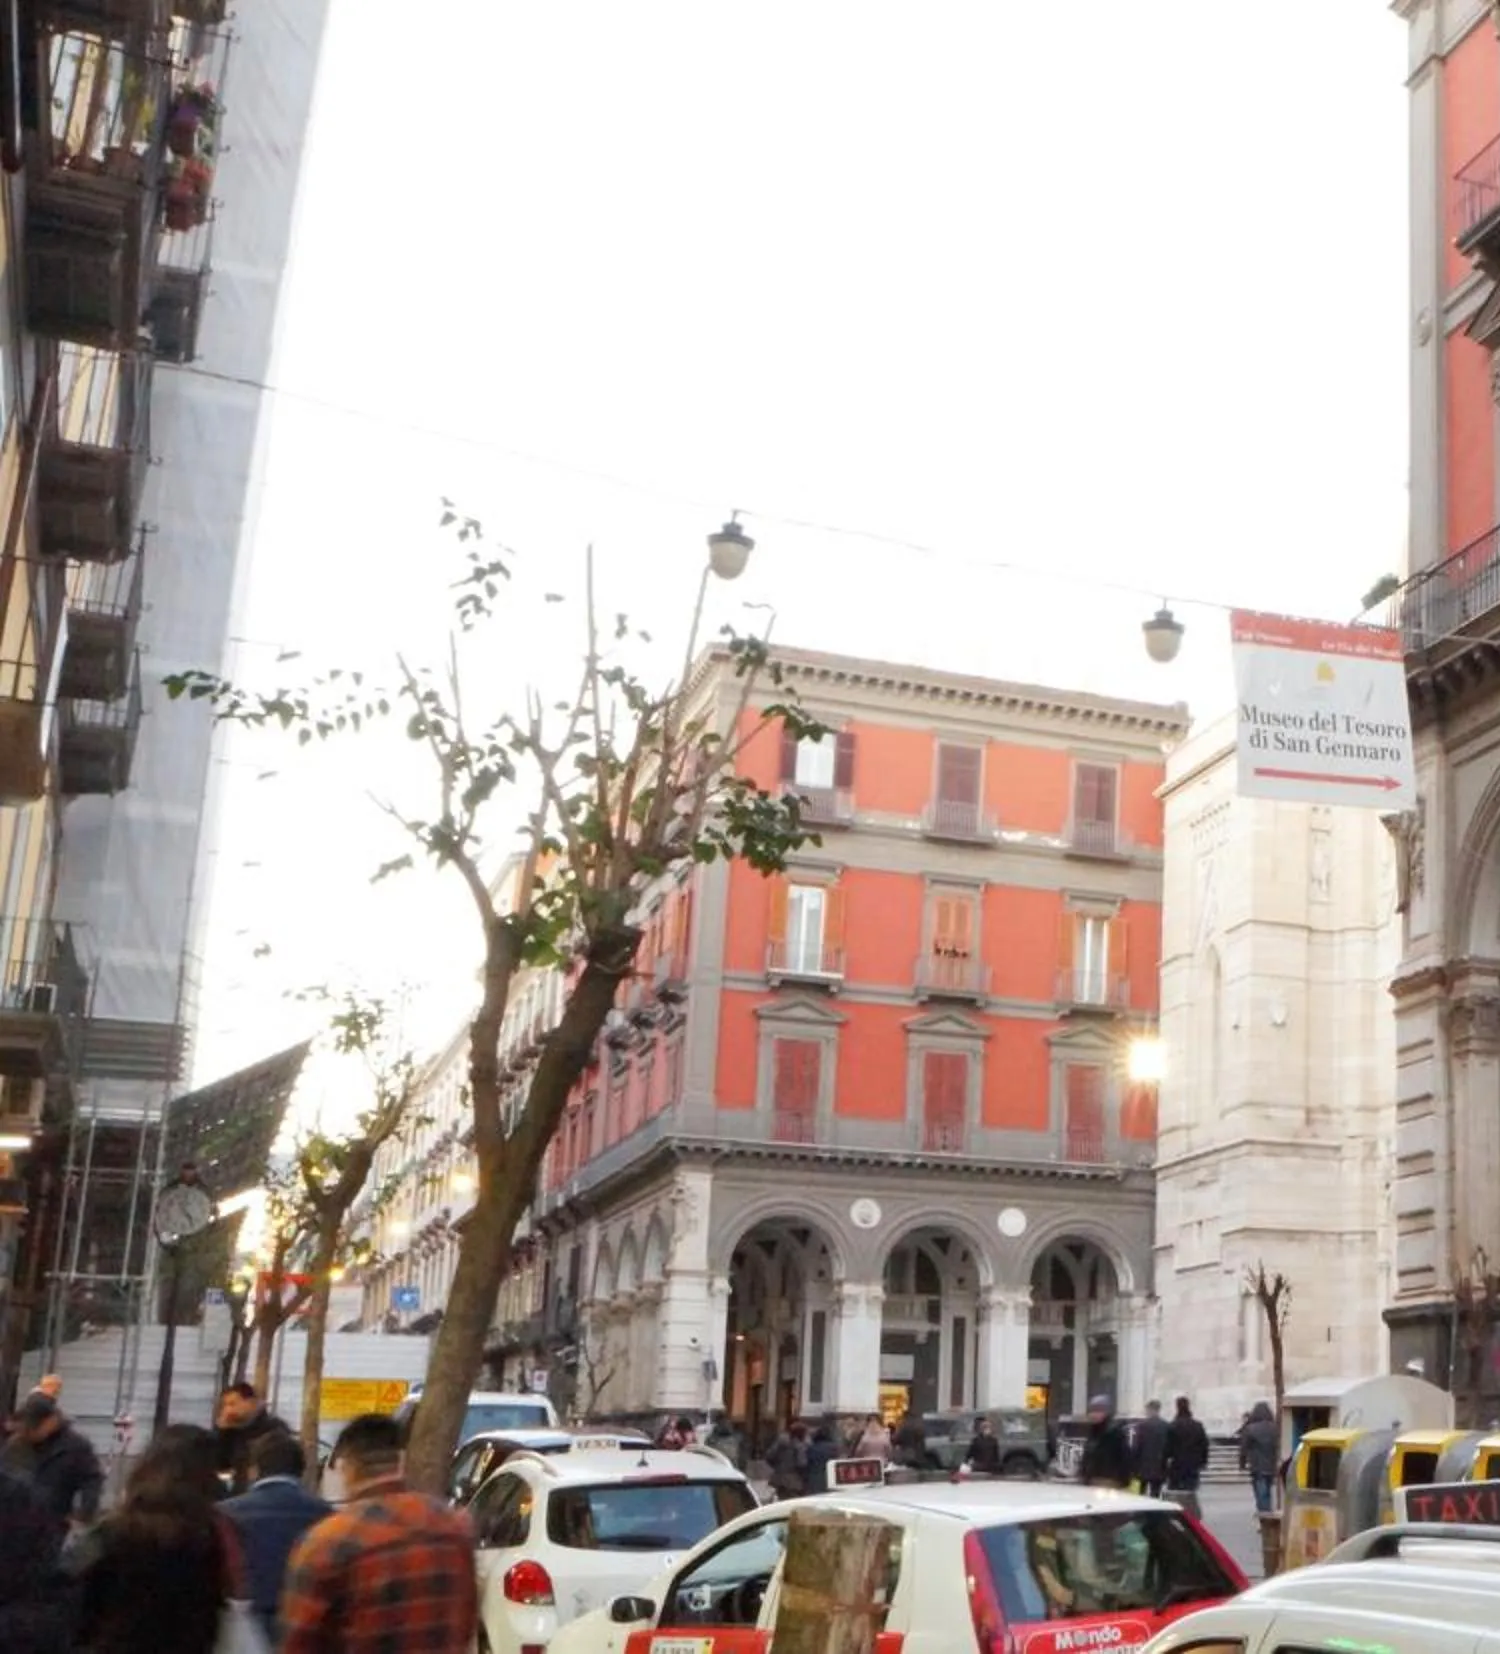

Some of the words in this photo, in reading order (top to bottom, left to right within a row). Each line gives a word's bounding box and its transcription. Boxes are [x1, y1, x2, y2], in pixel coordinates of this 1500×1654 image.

[1239, 703, 1304, 729] Museo
[1308, 711, 1337, 733] del
[1341, 714, 1407, 739] Tesoro
[1249, 727, 1268, 749] di
[1273, 731, 1310, 754] San
[1316, 735, 1402, 762] Gennaro
[1411, 1490, 1500, 1522] TAXI
